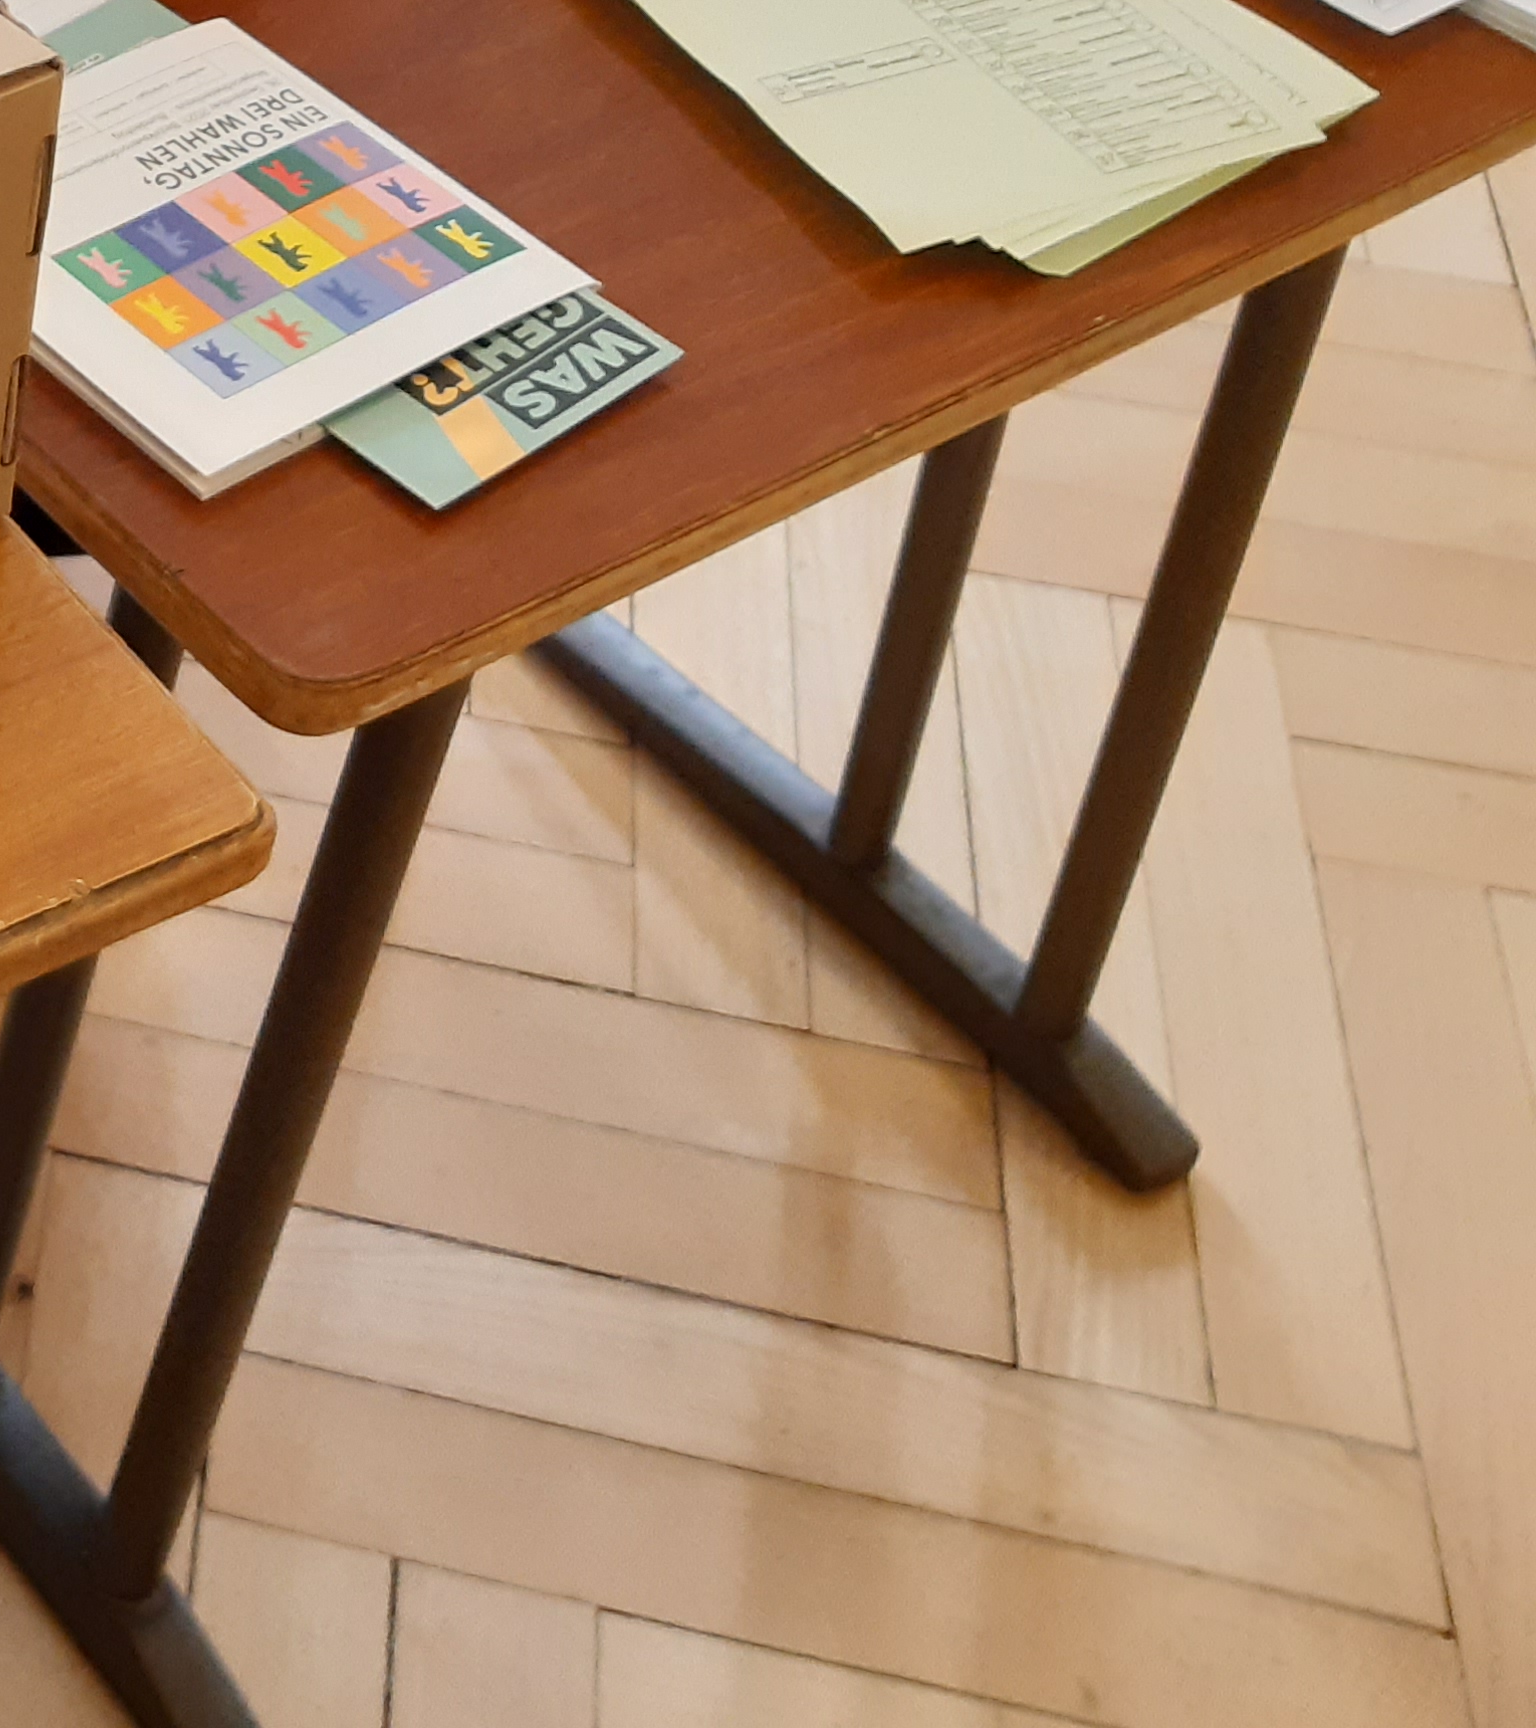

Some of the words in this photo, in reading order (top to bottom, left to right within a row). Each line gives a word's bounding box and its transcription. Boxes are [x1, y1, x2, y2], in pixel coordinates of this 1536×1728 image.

[241, 88, 304, 121] DREI
[279, 105, 328, 131] EIN
[135, 114, 246, 171] WAHLEN
[143, 123, 283, 189] SONNTAG,
[502, 328, 647, 419] WAS
